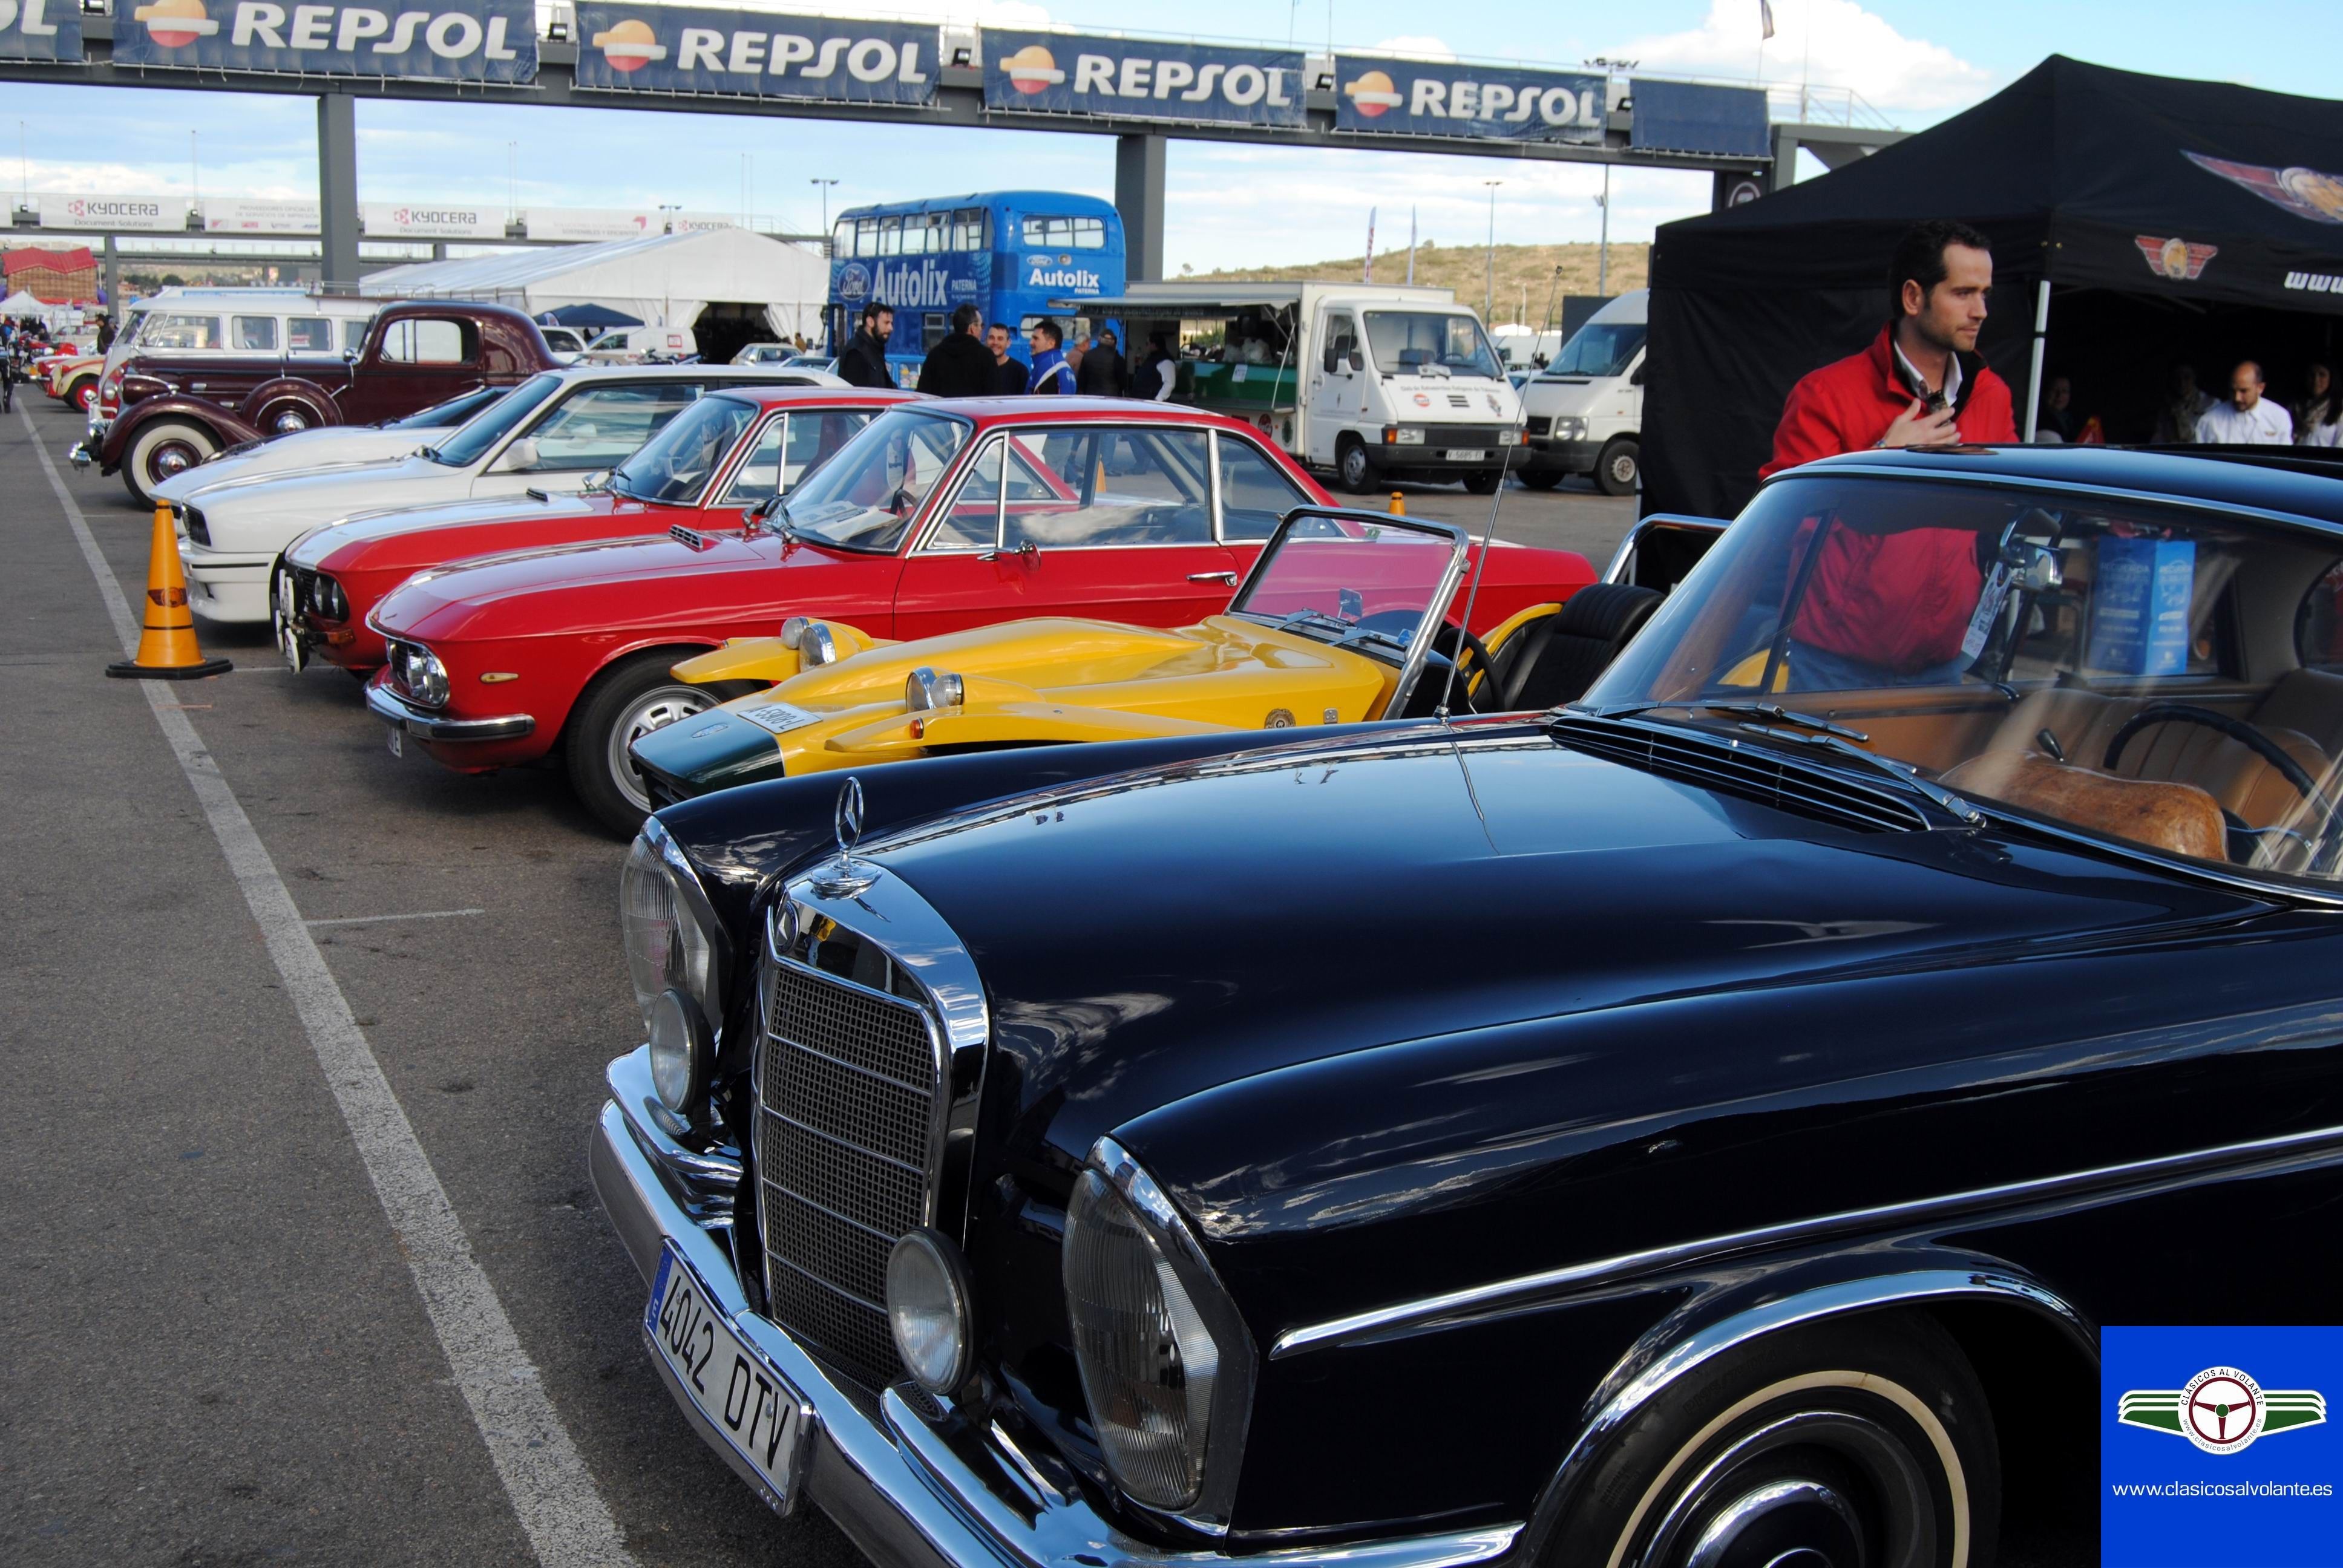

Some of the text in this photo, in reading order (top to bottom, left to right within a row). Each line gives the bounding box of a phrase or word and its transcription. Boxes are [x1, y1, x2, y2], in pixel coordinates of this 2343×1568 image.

[232, 1, 517, 60] REPSOL
[677, 28, 926, 83] REPSOL
[1074, 54, 1291, 106] REPSOL
[1410, 79, 1601, 128] REPSOL
[74, 218, 154, 228] Document Solutions
[871, 259, 949, 307] Autolix
[951, 279, 977, 291] PATERNA
[1029, 267, 1099, 288] Autolix
[651, 1298, 659, 1318] E
[660, 1275, 790, 1471] 4042 DTV
